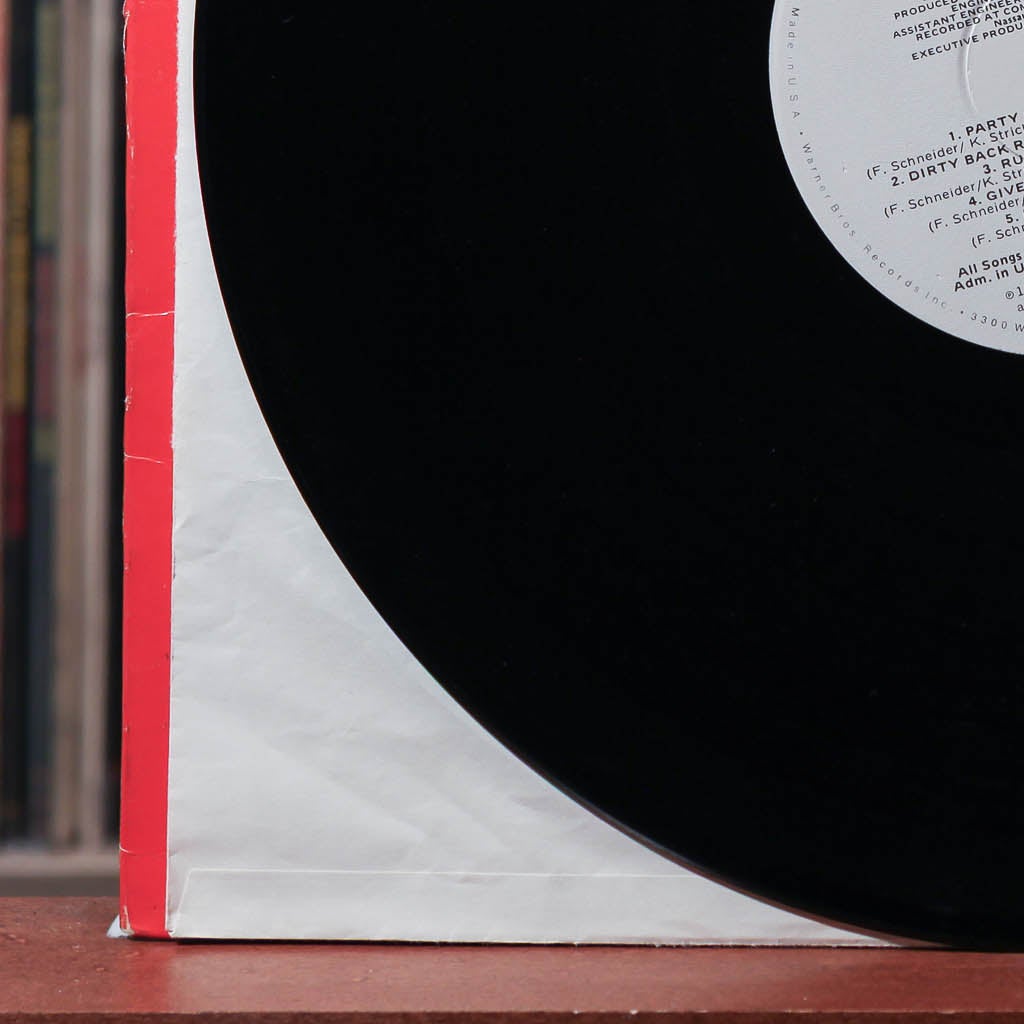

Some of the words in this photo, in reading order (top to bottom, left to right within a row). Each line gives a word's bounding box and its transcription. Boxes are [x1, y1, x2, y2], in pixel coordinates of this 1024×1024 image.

[893, 12, 958, 39] ASSISTANT
[913, 15, 983, 41] RECORDED
[981, 9, 1002, 23] AT
[911, 33, 980, 60] EXECUTIVE
[948, 130, 963, 141] 1.
[965, 111, 1018, 136] PARTY
[866, 164, 888, 180] (F.
[890, 171, 904, 187] 2.
[907, 157, 960, 181] DIRTY
[963, 141, 1011, 165] BACK
[982, 161, 997, 174] 3.
[967, 195, 982, 207] 4.
[884, 202, 904, 218] (F.
[1004, 211, 1019, 224] 5.
[928, 217, 948, 233] (F.
[971, 233, 991, 248] (F.
[958, 263, 980, 278] All
[981, 251, 1024, 273] Songs
[954, 270, 992, 292] Adm.
[994, 264, 1010, 280] in
[1016, 302, 1024, 312] a
[969, 311, 1008, 330] 3300
